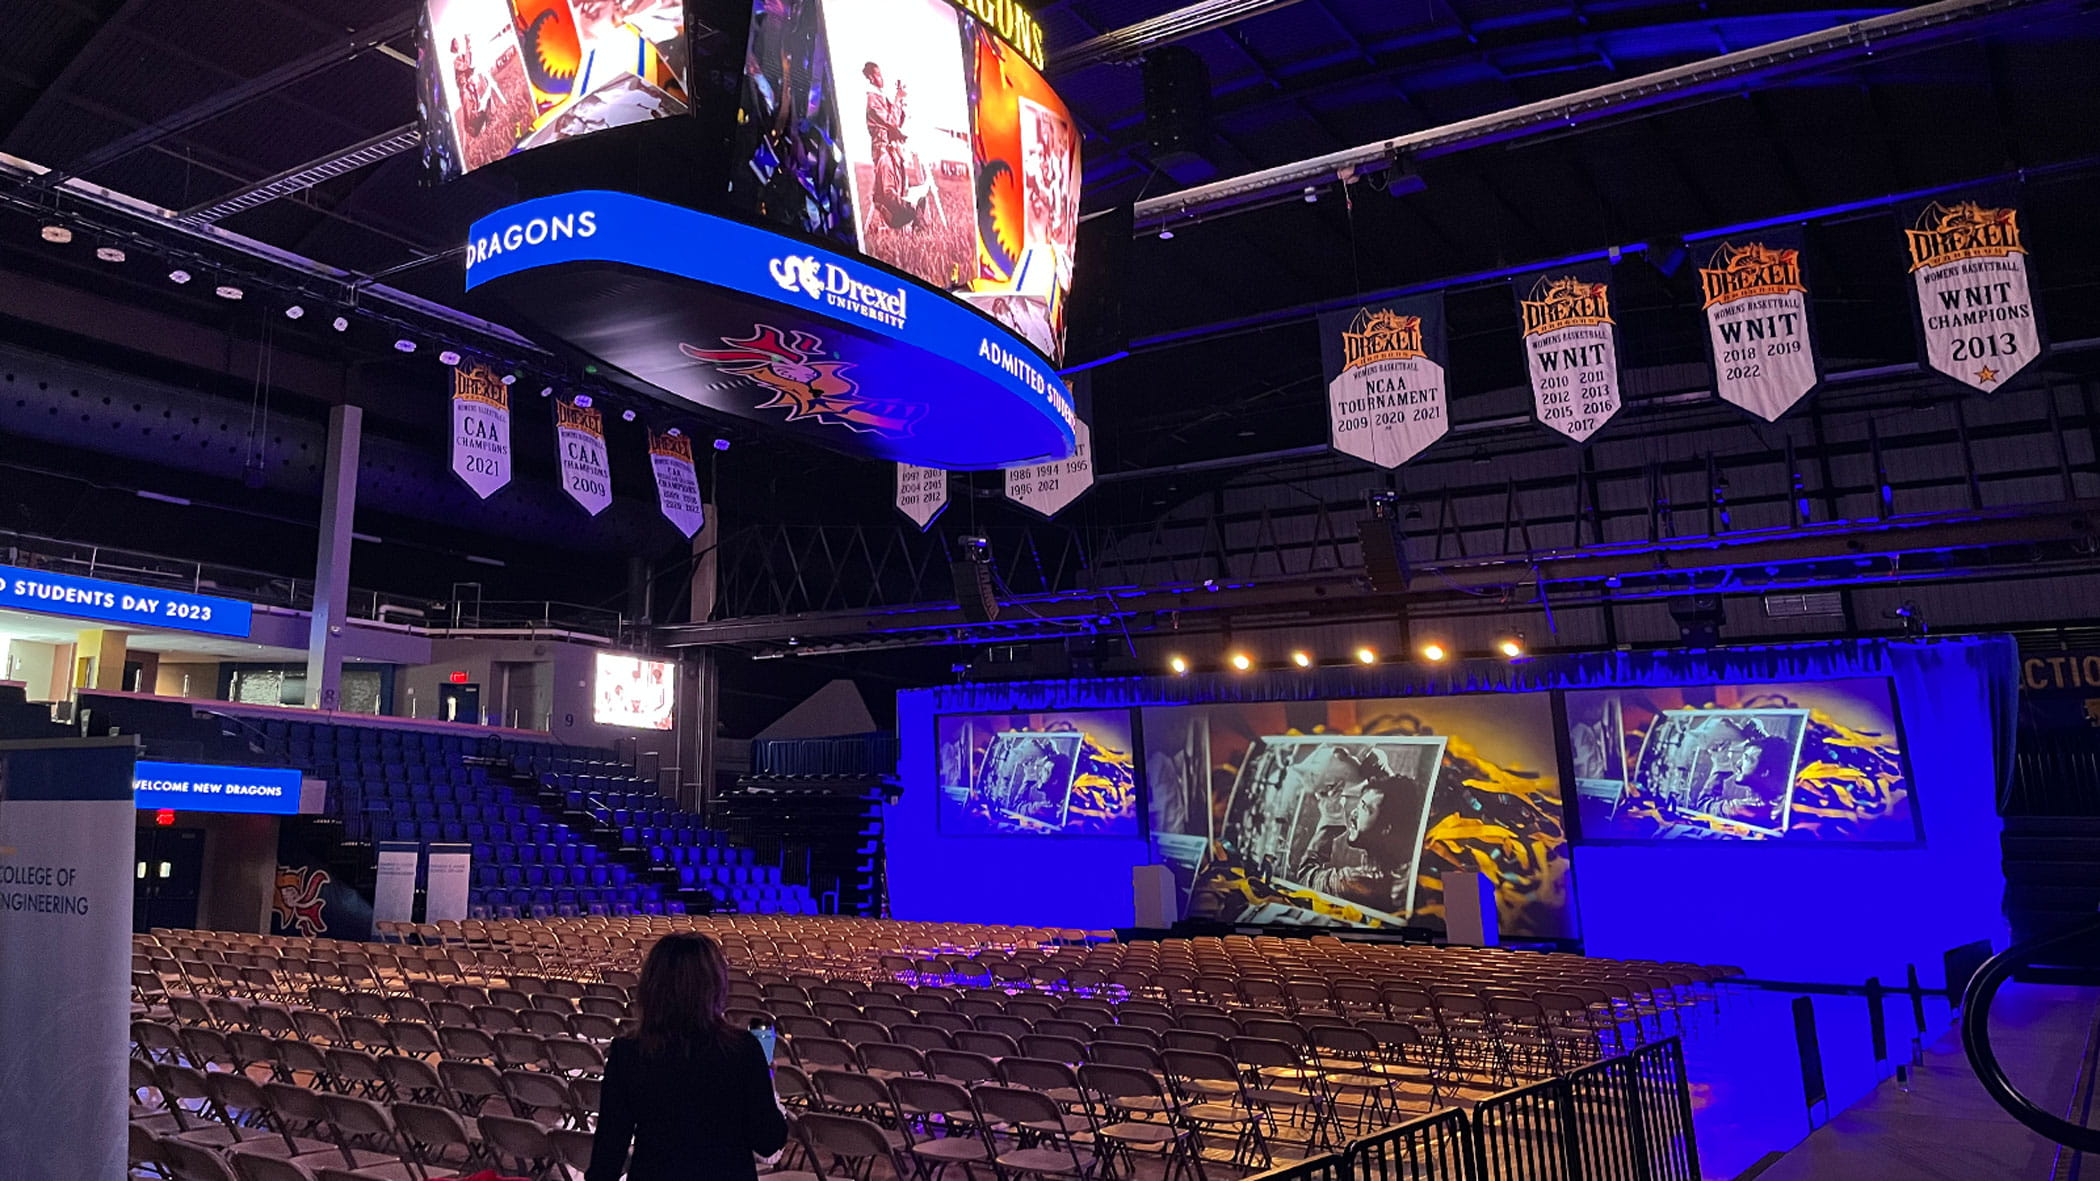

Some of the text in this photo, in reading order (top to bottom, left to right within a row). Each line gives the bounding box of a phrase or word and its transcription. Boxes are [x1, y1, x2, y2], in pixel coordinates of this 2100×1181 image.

[466, 210, 597, 270] DRAGONS
[1913, 222, 2016, 262] DREXEL
[825, 263, 907, 319] Drexel
[1707, 264, 1798, 299] DREXEL
[1938, 282, 2011, 311] WNIT
[827, 292, 905, 330] UNIVERSITY
[1527, 298, 1605, 330] DREXEL
[1928, 304, 2030, 330] CHAMPIONS
[1718, 312, 1798, 344] WNIT
[1348, 329, 1420, 361] DREXEL
[1538, 344, 1605, 372] WNIT
[1724, 341, 1801, 363] 2018 2019
[1951, 332, 2017, 361] 2013
[979, 337, 1045, 395] ADMITTED
[1726, 365, 1761, 380] 2022
[1366, 376, 1406, 395] NCAA
[1540, 370, 1604, 390] 2010 2011
[1338, 388, 1438, 415] TOURNAMENT
[1542, 385, 1610, 405] 2012 2013
[1338, 406, 1440, 432] 2009 2020 2021
[1544, 400, 1612, 420] 2015 2016
[464, 416, 498, 442] CAA
[1567, 419, 1595, 433] 2017
[456, 437, 508, 455] CHAMPIONS
[568, 442, 600, 467] CAA
[466, 455, 499, 476] 2021
[1010, 469, 1031, 481] 1986
[1037, 464, 1059, 476] 1994
[572, 476, 605, 496] 2009
[1038, 479, 1059, 492] 2021
[15, 580, 115, 608] STUDENTS
[121, 595, 159, 614] DAY
[166, 602, 212, 621] 2023
[2020, 655, 2100, 689] CTIO
[565, 713, 574, 727] 9
[193, 782, 222, 794] NEW
[225, 784, 283, 797] DRAGONS
[57, 868, 76, 886] OF
[0, 892, 89, 915] NGINEERING
